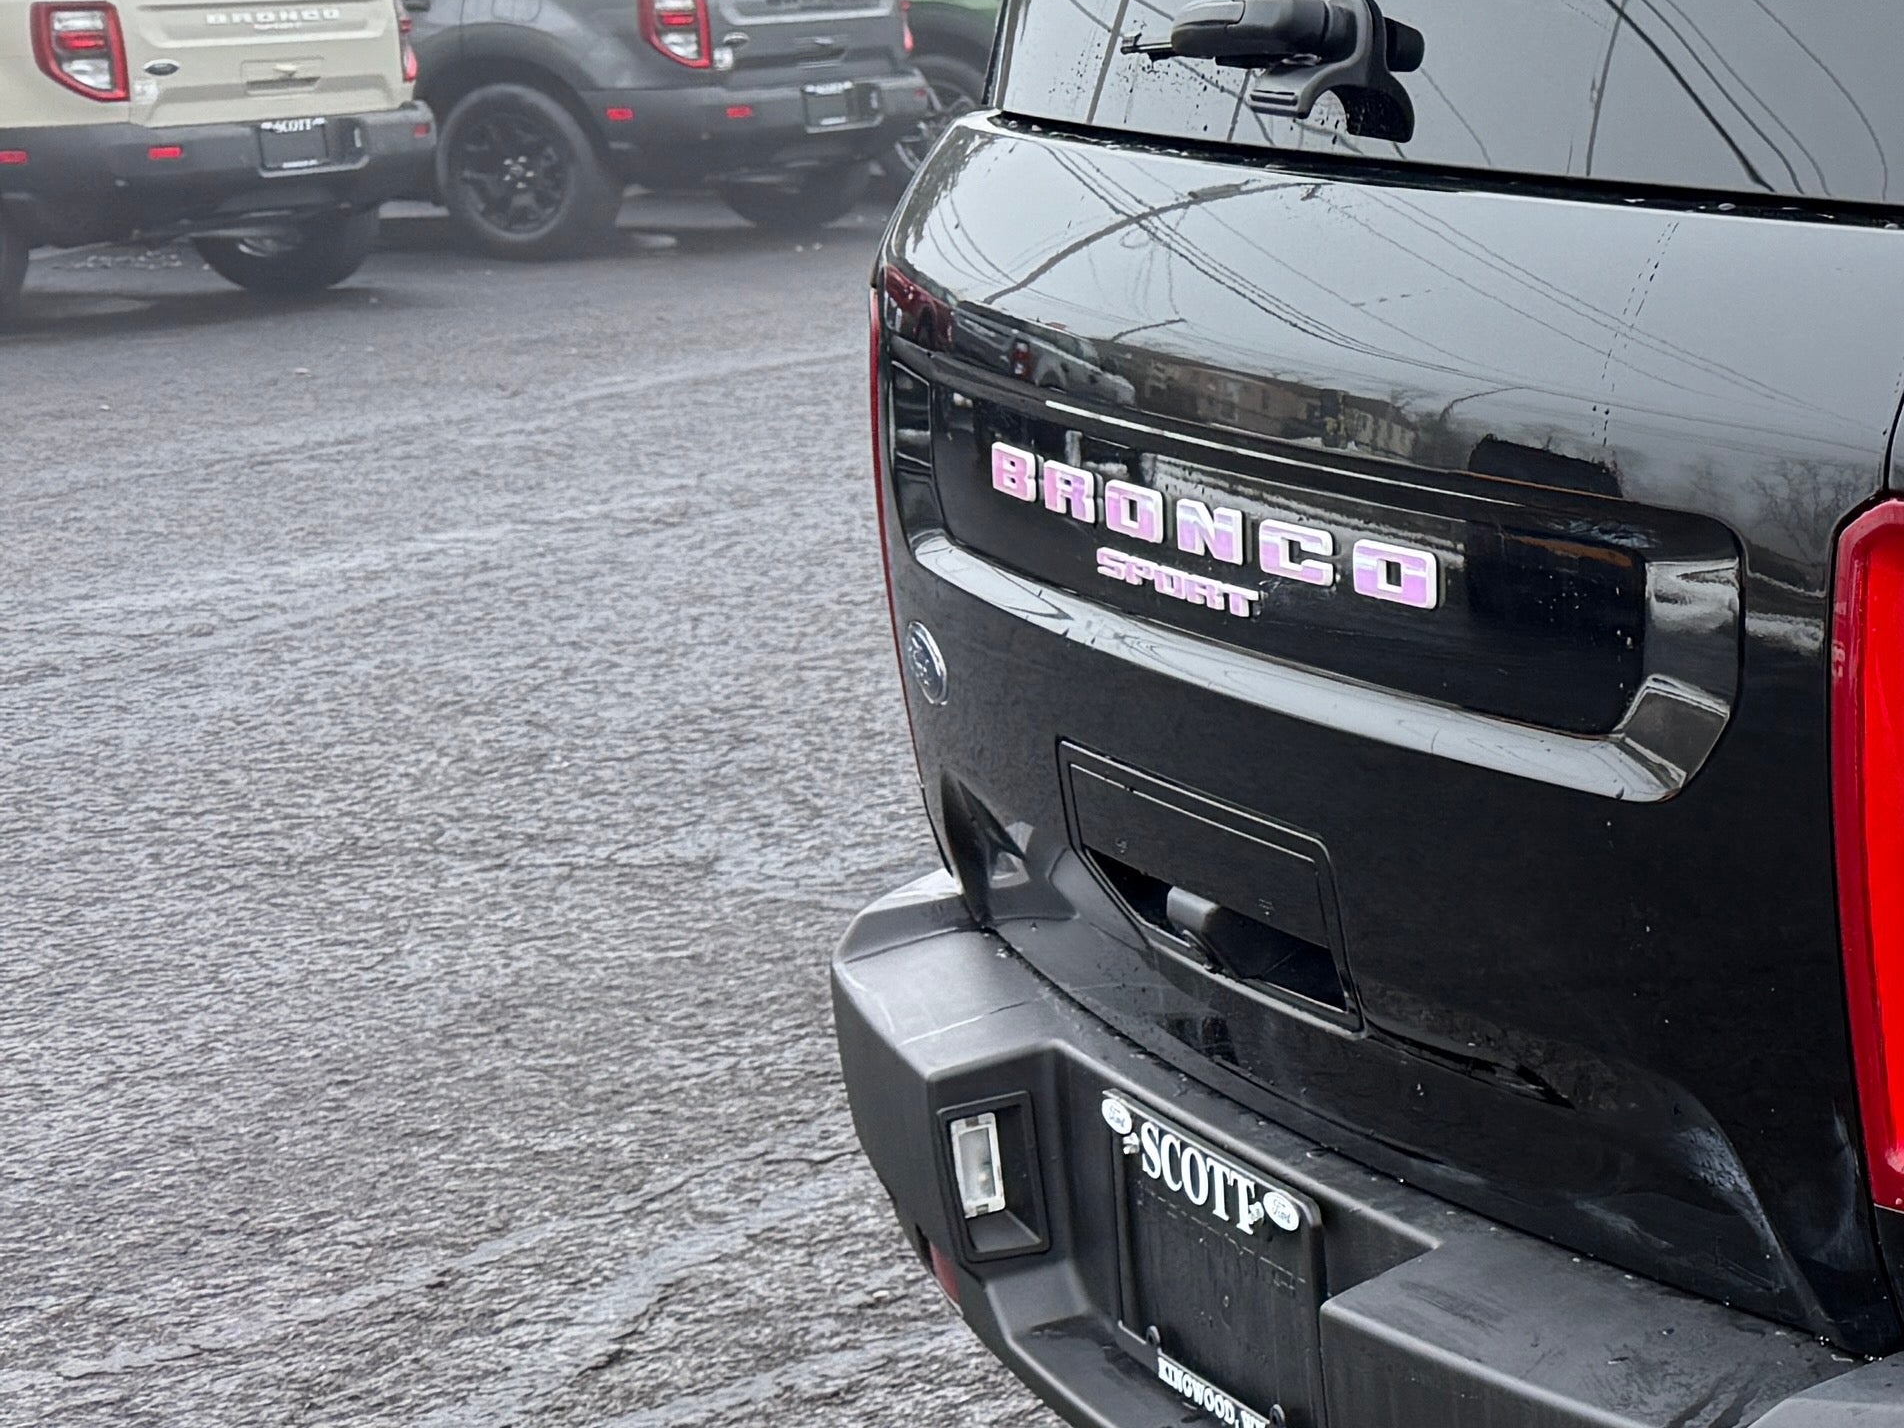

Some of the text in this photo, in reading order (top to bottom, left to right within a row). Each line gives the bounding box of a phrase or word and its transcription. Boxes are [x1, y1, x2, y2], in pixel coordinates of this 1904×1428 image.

[990, 440, 1439, 611] BRONCO
[1096, 546, 1261, 618] SPORT
[1140, 1121, 1256, 1235] SCOTT
